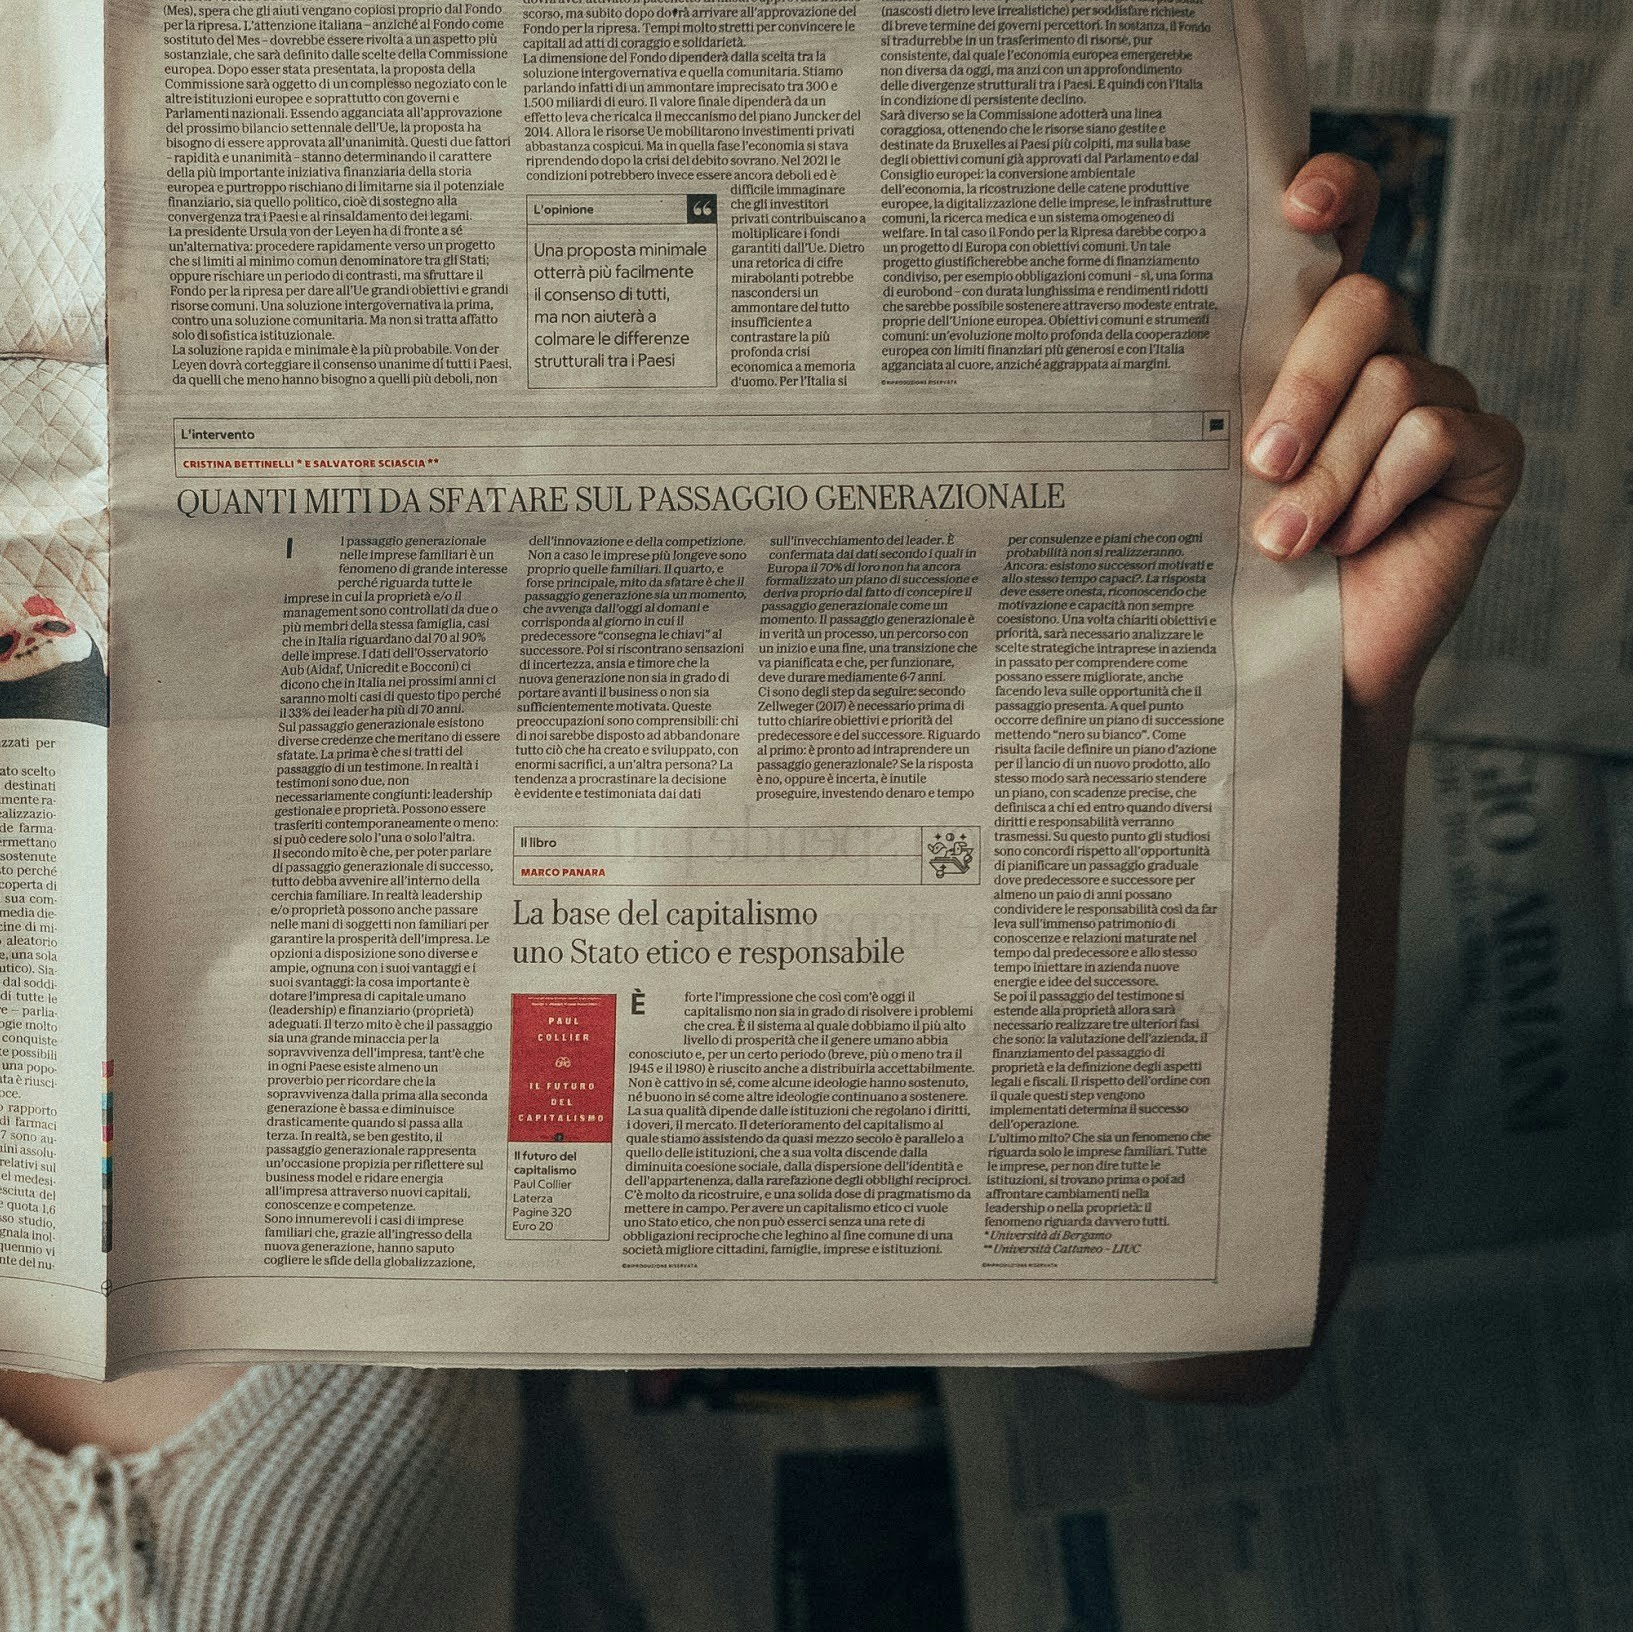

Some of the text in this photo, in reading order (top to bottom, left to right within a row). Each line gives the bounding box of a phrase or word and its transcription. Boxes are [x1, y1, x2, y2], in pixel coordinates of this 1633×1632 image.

[533, 204, 595, 217] L'opinione
[533, 241, 707, 261] Una proposta minimale
[533, 263, 695, 282] otterrà più facilmente
[181, 428, 255, 440] L'intervento
[182, 460, 233, 469] CRISTINA
[233, 460, 295, 469] BETTINELLI
[313, 459, 376, 468] SALVATORE
[377, 458, 427, 468] SCIASCIA
[175, 482, 1066, 521] QUANTI MITI DA SFATARE SUL PASSAGGIO GENERAZIONALE
[529, 836, 557, 848] libro
[521, 868, 606, 877] MARCO PANARA
[513, 896, 820, 934] La base del capitalismo
[513, 935, 906, 972] uno Stato etico e responsabile
[547, 1016, 579, 1026] PAUL
[537, 1033, 589, 1042] COLLIER
[550, 1098, 573, 1107] DEL
